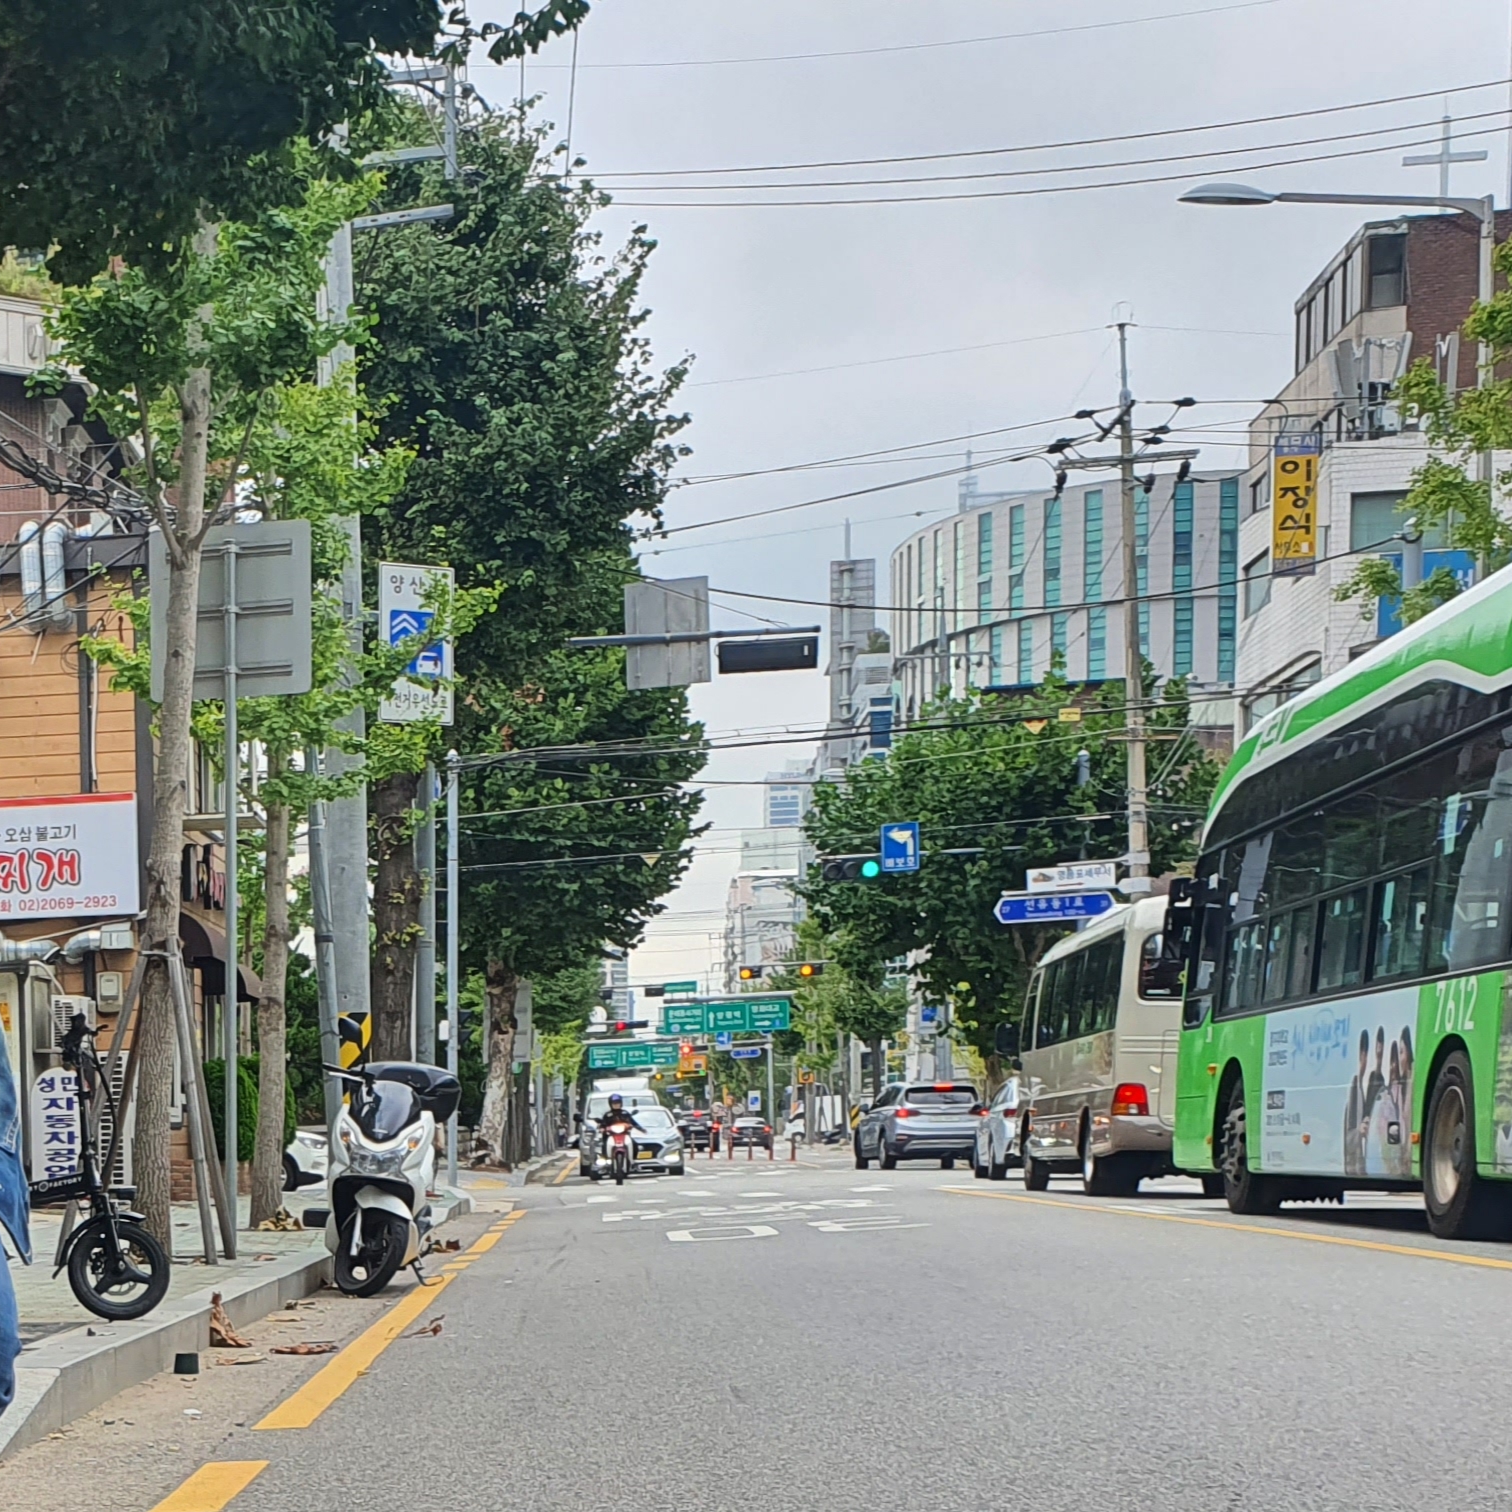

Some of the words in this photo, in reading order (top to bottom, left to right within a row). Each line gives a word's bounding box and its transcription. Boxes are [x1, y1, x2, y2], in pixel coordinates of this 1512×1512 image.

[1278, 458, 1311, 535] 이장식
[35, 823, 77, 842] 불고기
[18, 895, 118, 913] 02)2069-2923
[1434, 975, 1478, 1034] 7612
